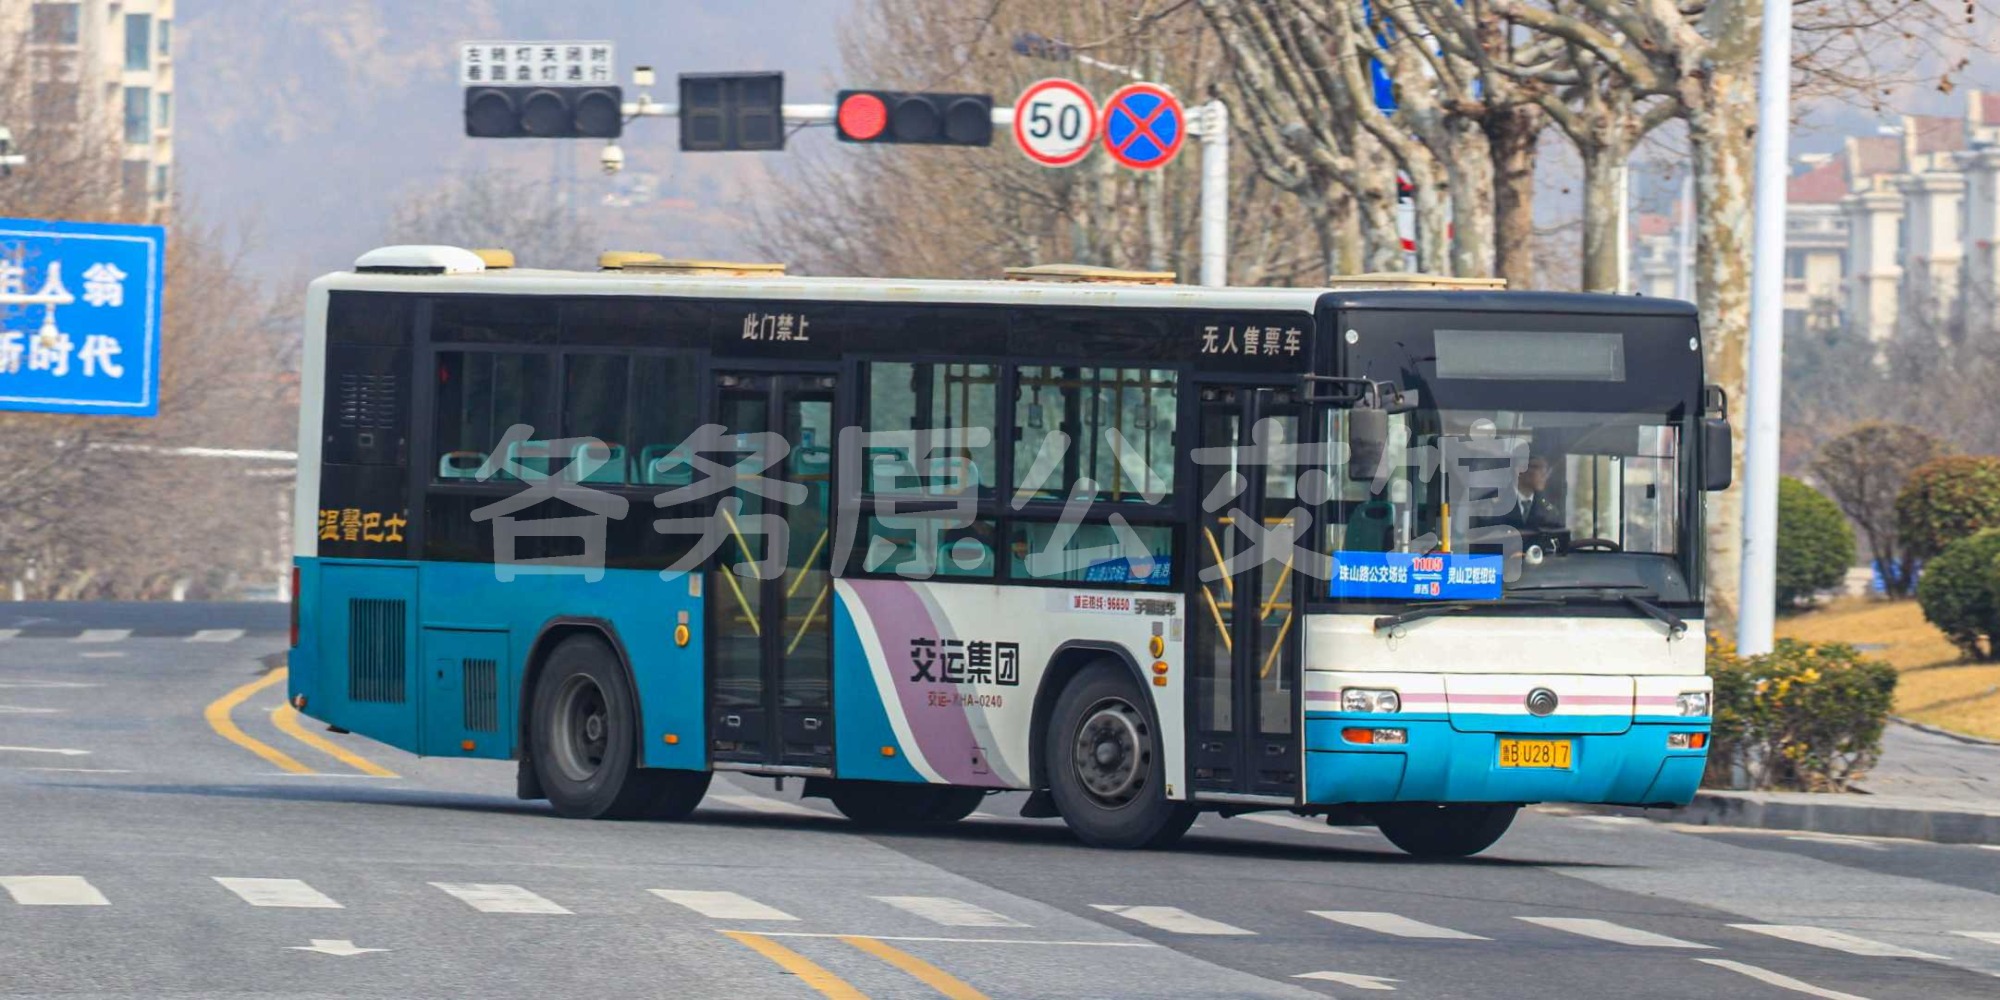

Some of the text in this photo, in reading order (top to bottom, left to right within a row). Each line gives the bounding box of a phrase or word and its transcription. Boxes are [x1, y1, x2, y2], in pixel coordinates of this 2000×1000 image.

[1030, 102, 1082, 141] 50
[742, 313, 809, 341] 此门禁上
[1201, 325, 1302, 357] 无人售票车
[1339, 560, 1408, 583] 珠山路公交场站
[1412, 557, 1443, 572] 1105
[910, 638, 1019, 686] 交运集团
